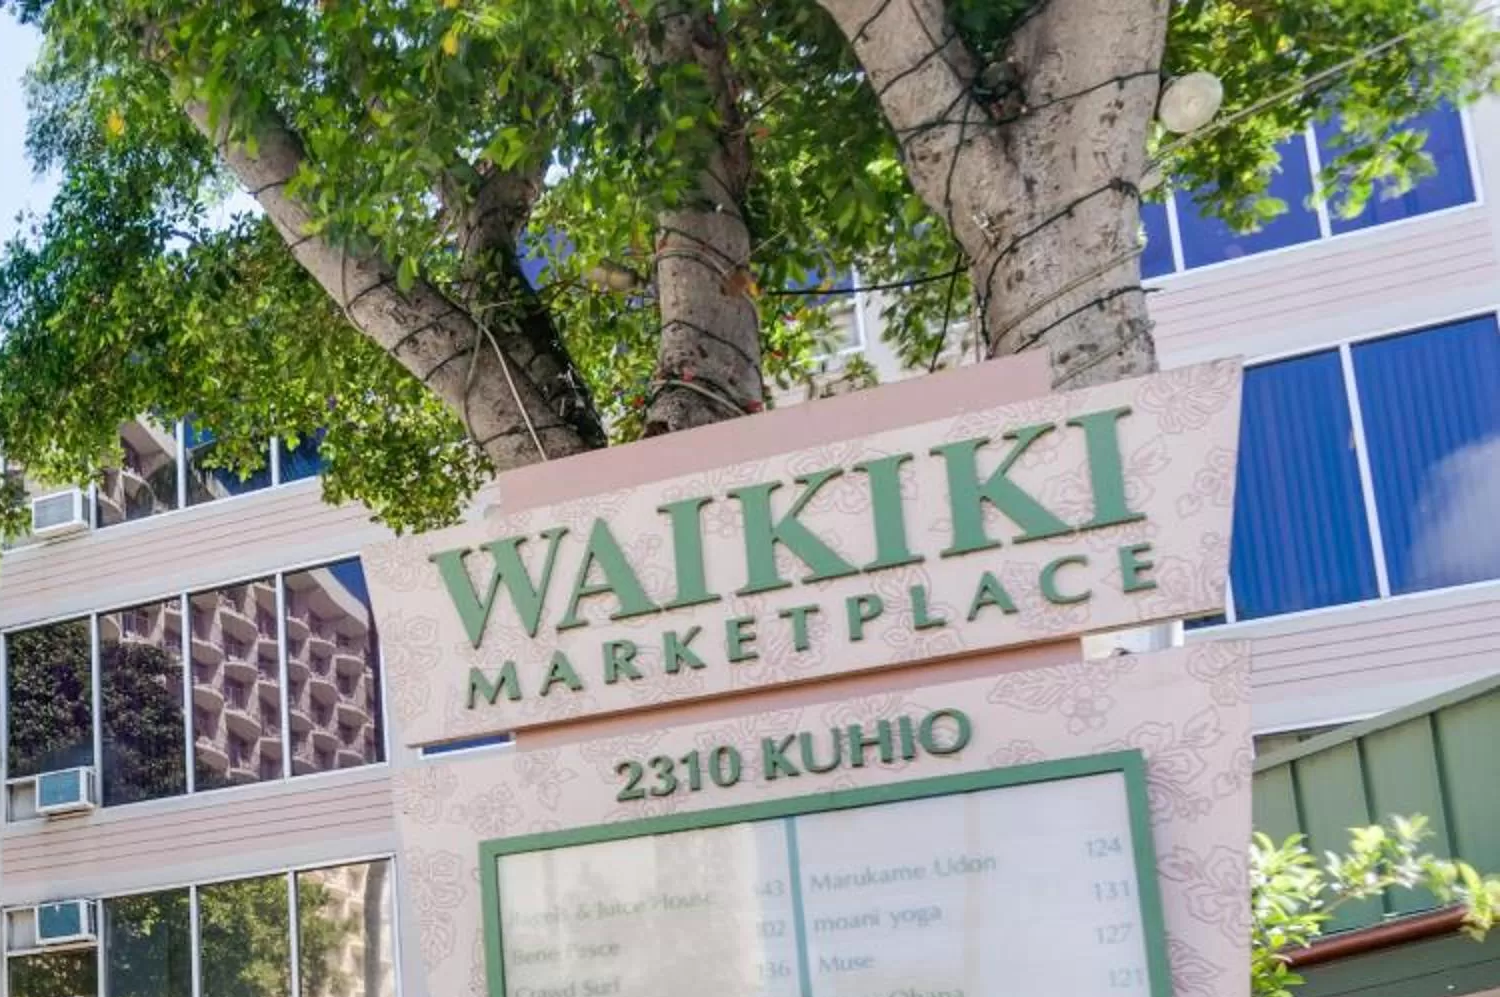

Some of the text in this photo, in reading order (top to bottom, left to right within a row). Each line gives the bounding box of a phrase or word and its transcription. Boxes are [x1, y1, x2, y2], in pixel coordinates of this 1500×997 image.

[430, 405, 1146, 649] WAIKIKI
[465, 543, 1159, 711] MARKETPLACE
[614, 708, 975, 802] 2310 KUHIO
[1085, 837, 1122, 858] 124
[934, 855, 997, 879] Udon
[1094, 881, 1130, 902] 131
[890, 904, 943, 929] yoga
[1096, 923, 1133, 944] 127
[818, 955, 875, 974] Muse
